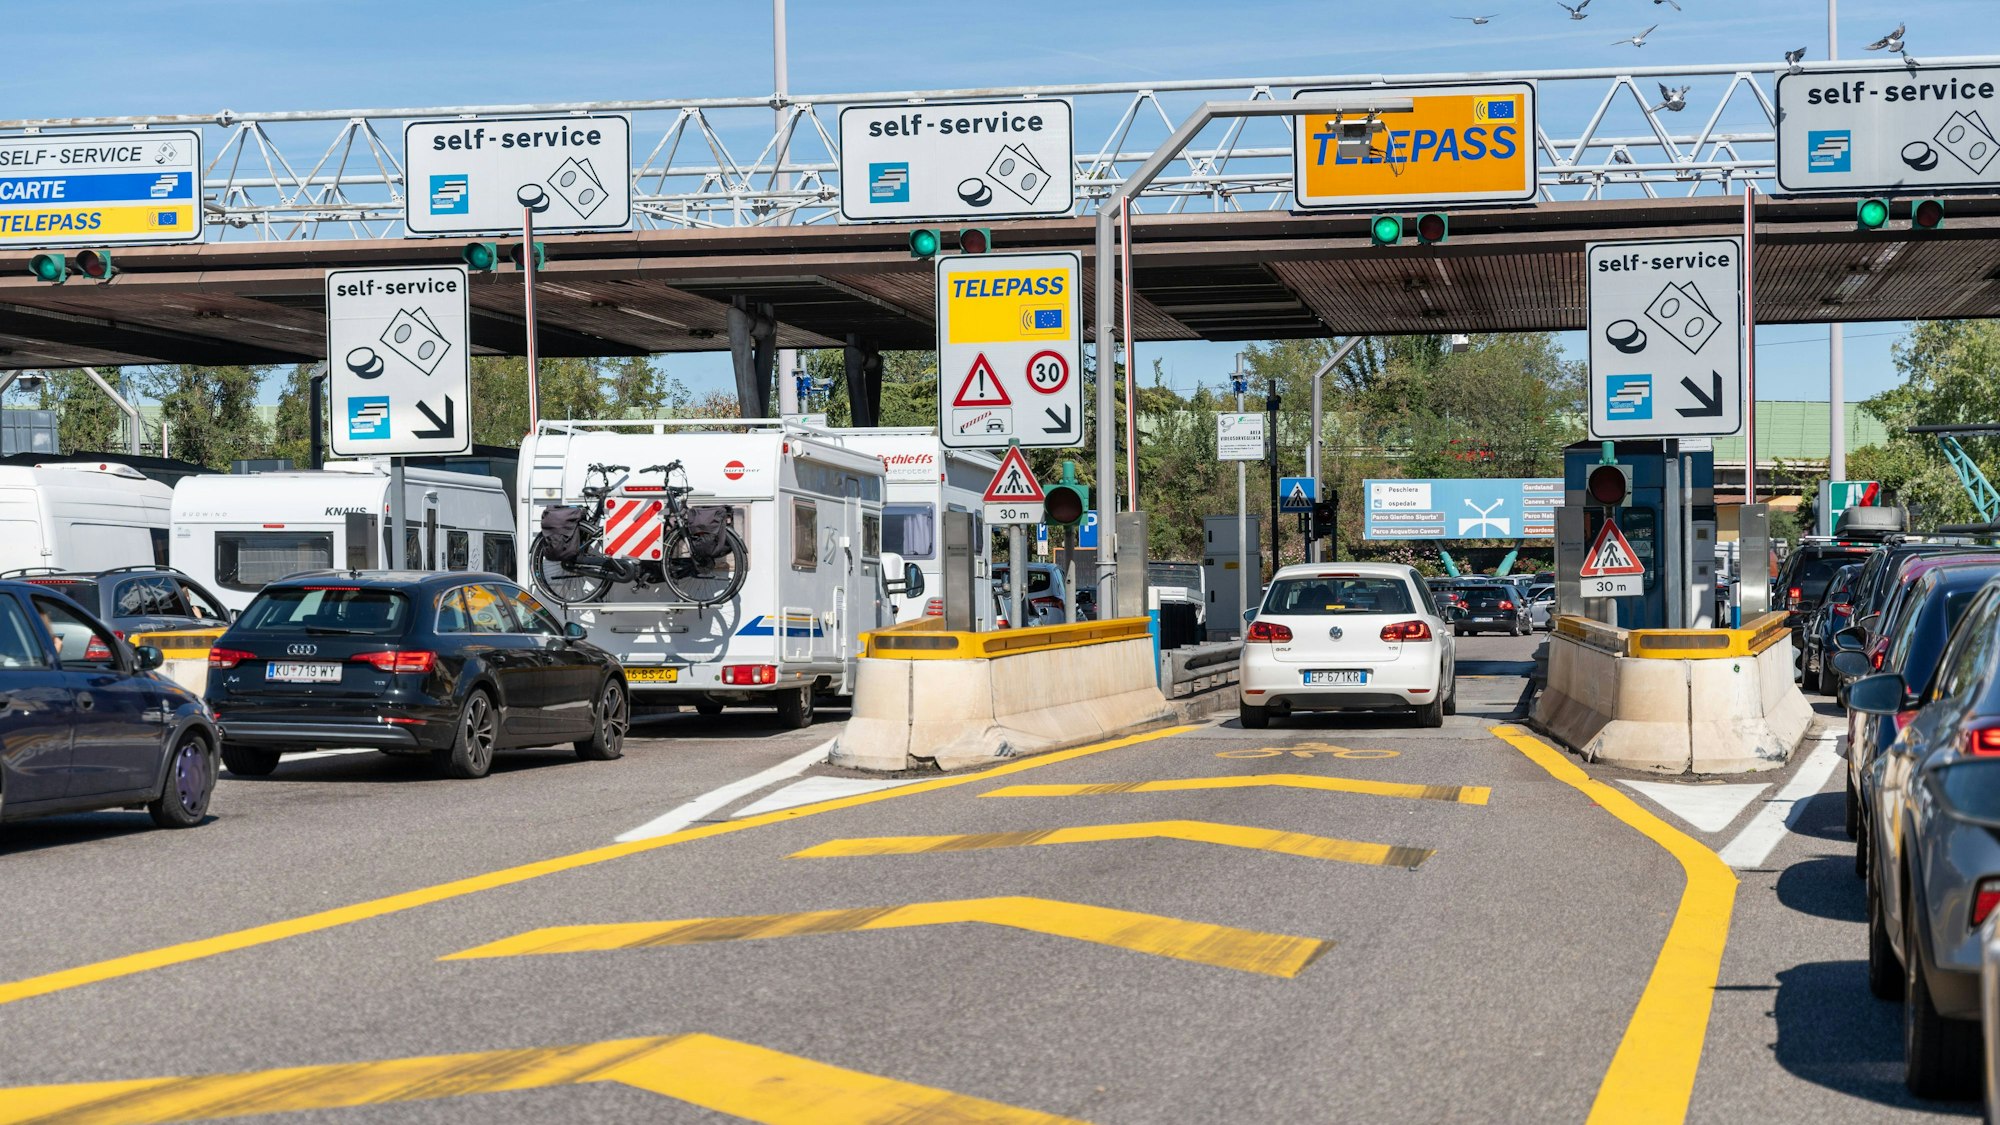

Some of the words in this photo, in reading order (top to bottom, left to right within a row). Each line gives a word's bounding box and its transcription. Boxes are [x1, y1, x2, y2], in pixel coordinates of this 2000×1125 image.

[1807, 77, 1995, 105] self-service
[868, 111, 1043, 138] self-service
[432, 125, 601, 151] self-service
[0, 146, 143, 167] SELF-SERVICE
[0, 180, 67, 200] CARTE
[0, 212, 102, 233] TELEPASS
[1598, 251, 1731, 273] self-service
[336, 277, 457, 297] self-service
[953, 276, 1065, 298] TELEPASS
[1035, 362, 1060, 383] 30
[325, 506, 367, 516] KNAUS
[1000, 509, 1017, 520] 30
[1019, 511, 1030, 519] m
[1596, 581, 1614, 593] 30
[1616, 584, 1627, 593] m
[275, 665, 290, 676] KU
[299, 665, 317, 677] 719
[320, 665, 336, 677] WY
[1311, 672, 1324, 682] EP
